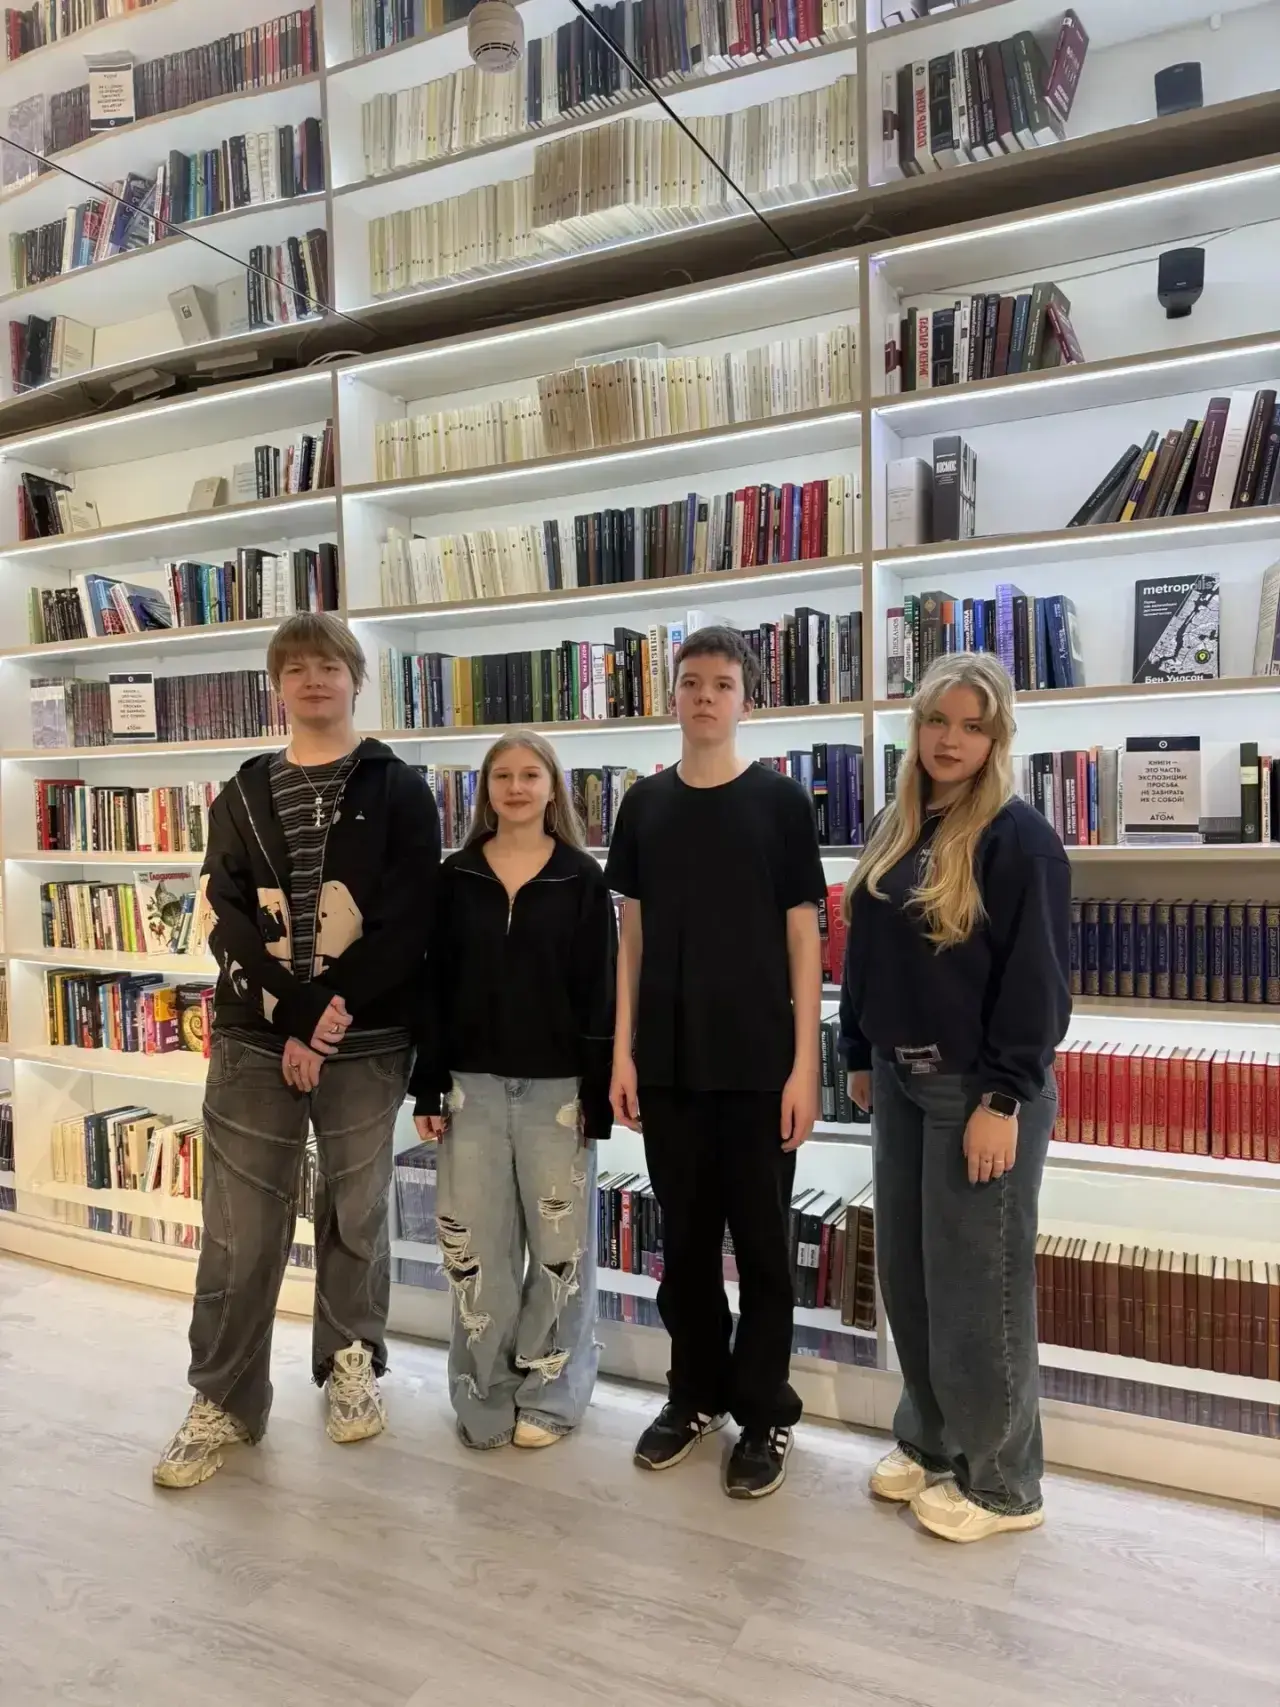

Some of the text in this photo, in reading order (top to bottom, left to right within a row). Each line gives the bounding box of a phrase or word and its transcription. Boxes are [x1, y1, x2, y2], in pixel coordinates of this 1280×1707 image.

[936, 460, 957, 474] КОСМОС
[1143, 579, 1213, 595] metropolis
[1144, 674, 1204, 684] Бен Уилсон
